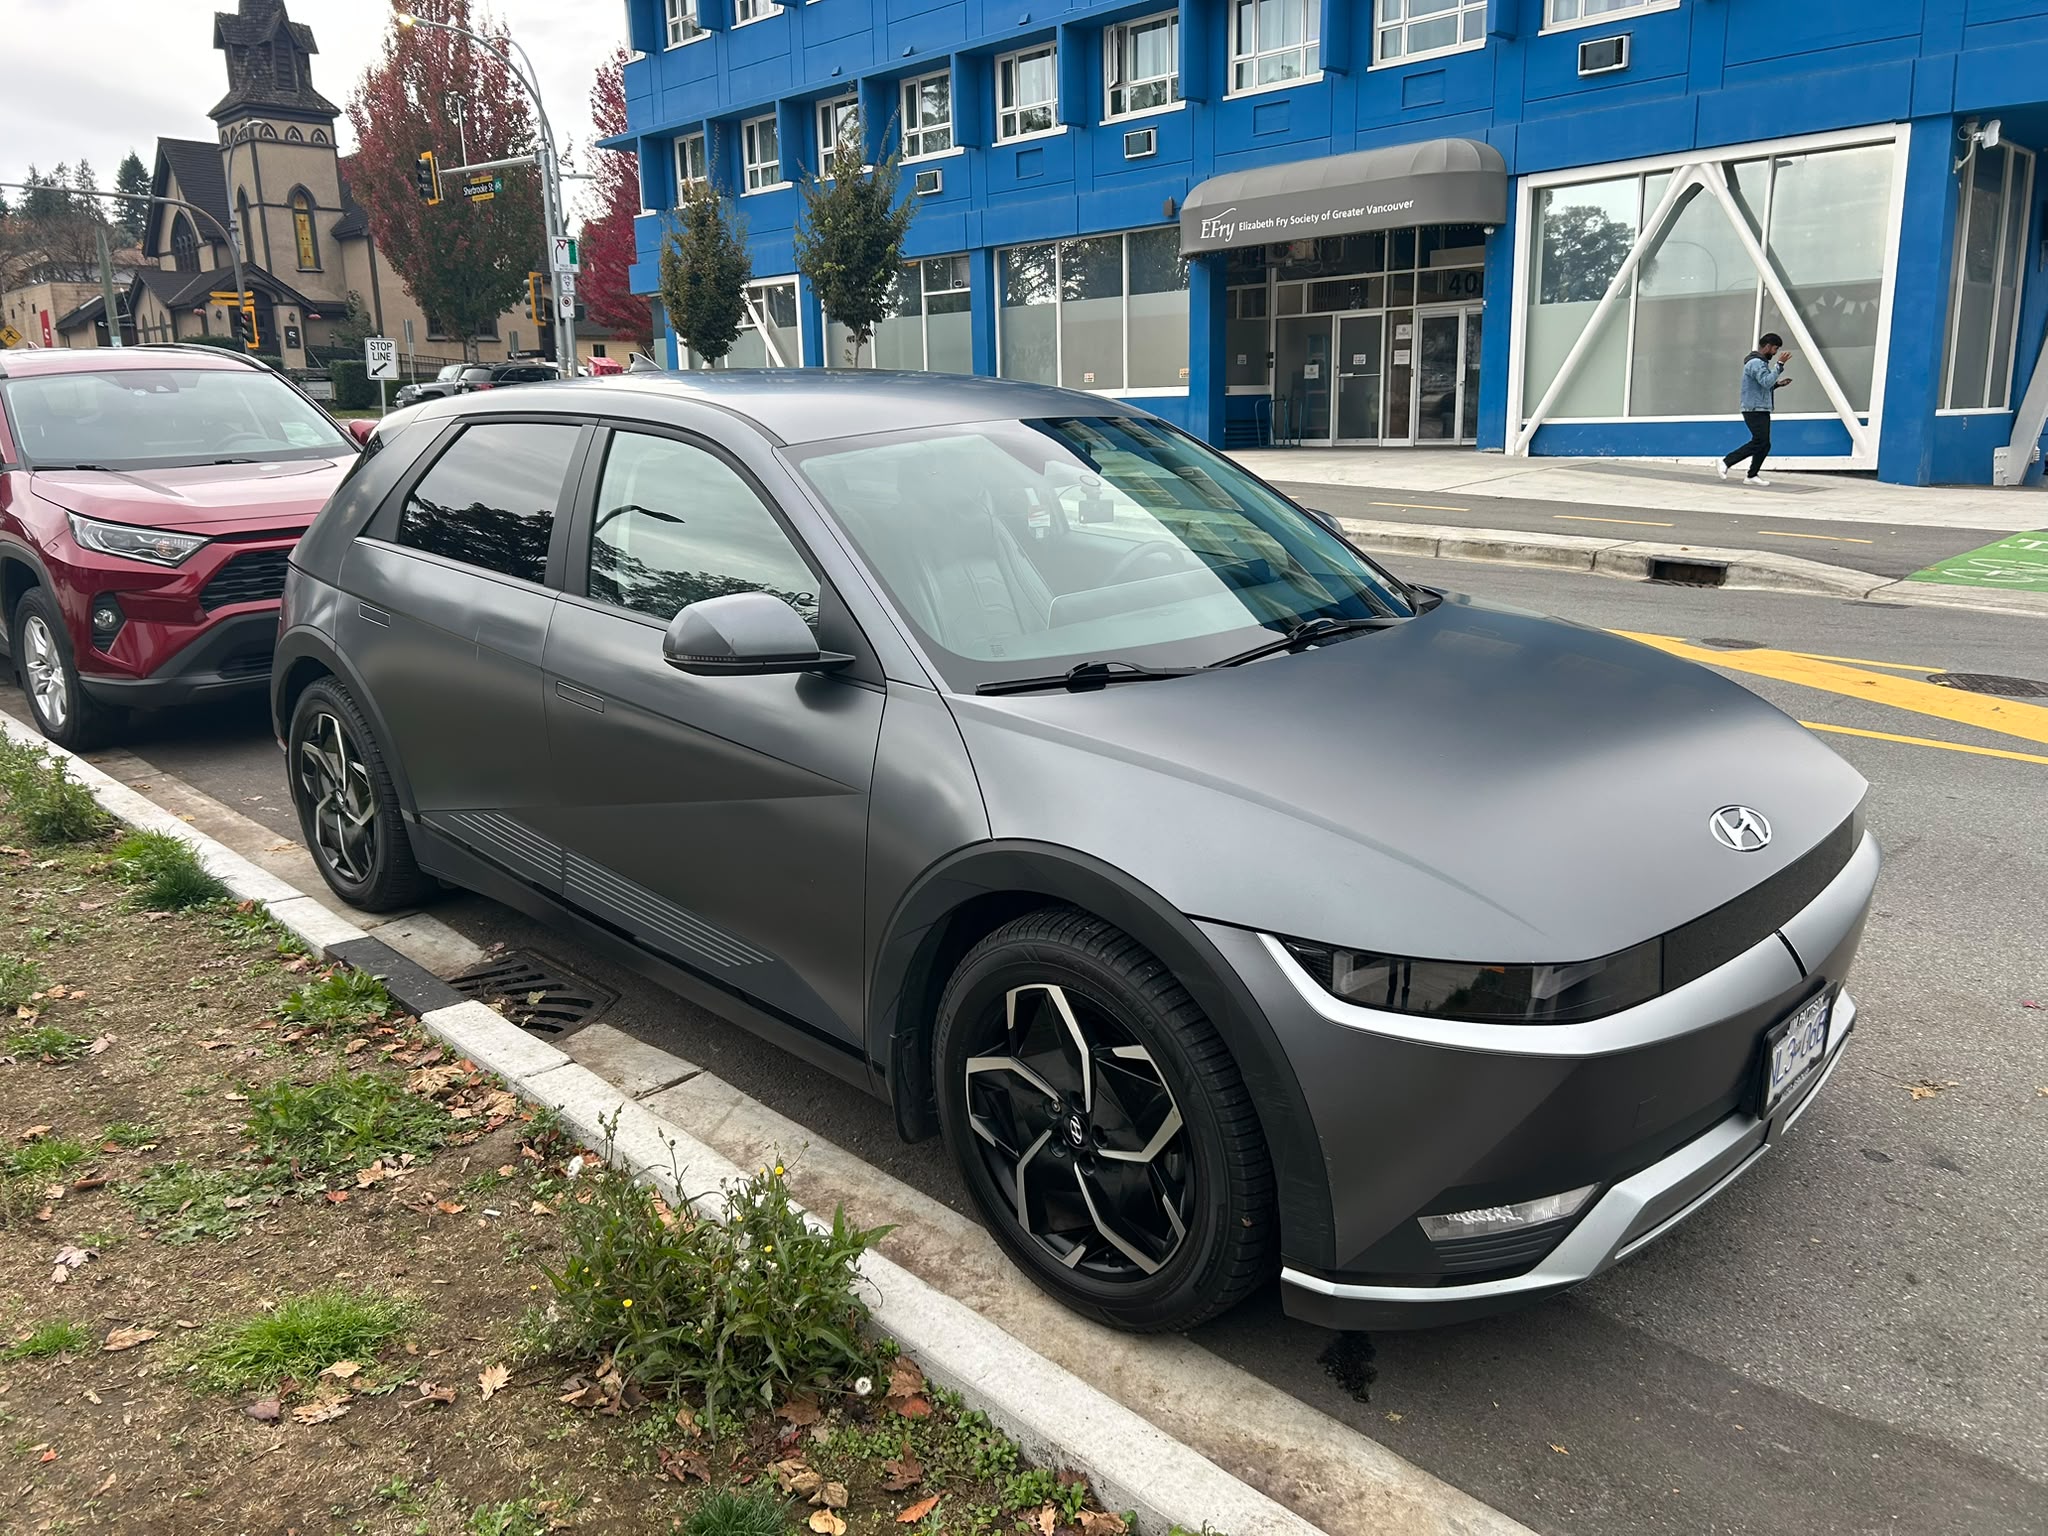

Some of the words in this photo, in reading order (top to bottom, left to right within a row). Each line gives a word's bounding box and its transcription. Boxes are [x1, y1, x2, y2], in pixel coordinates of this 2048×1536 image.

[463, 184, 488, 196] Sherbrooke
[1238, 219, 1274, 231] Elizabeth
[1276, 217, 1288, 228] Fry
[1290, 213, 1319, 225] Society
[1321, 210, 1331, 221] of
[1332, 208, 1365, 219] Greater
[1366, 199, 1414, 215] Vancouver
[1200, 213, 1236, 242] EFry
[370, 341, 392, 351] STOP
[372, 352, 392, 361] LINE
